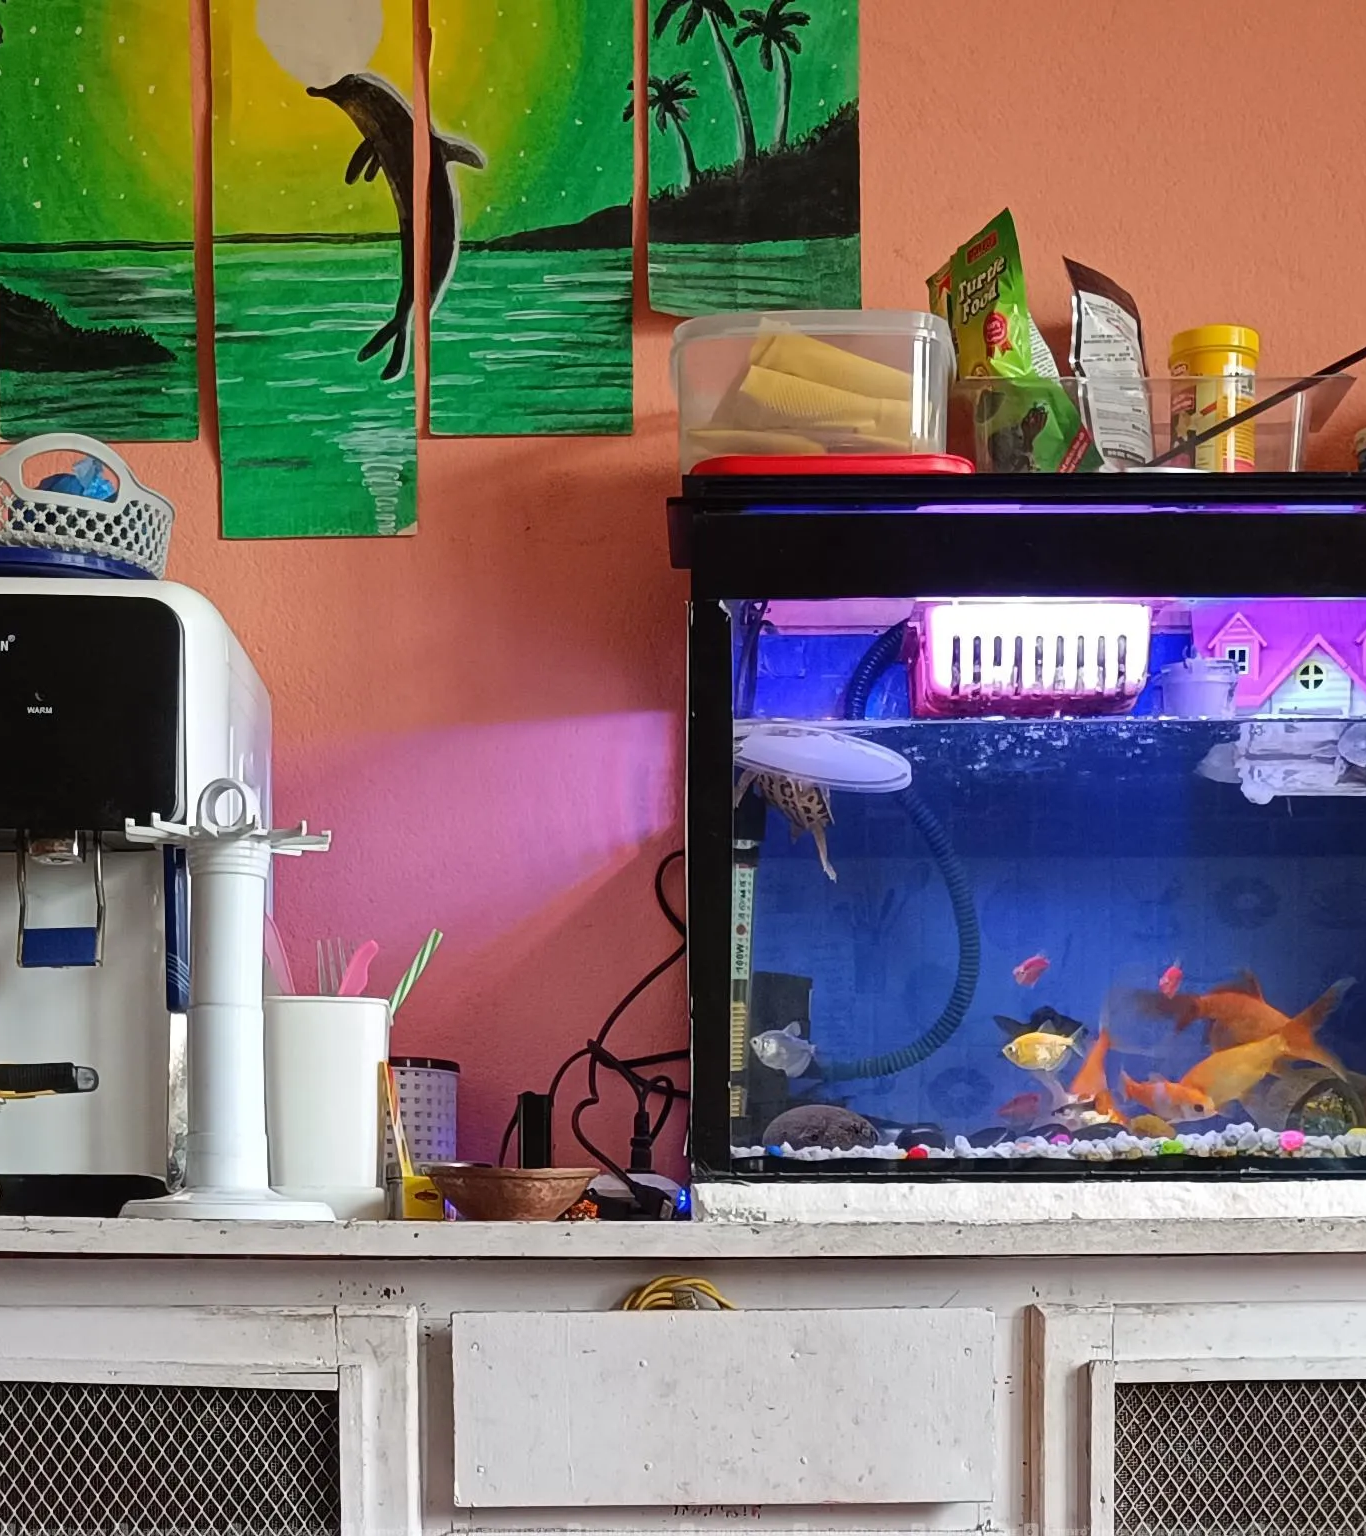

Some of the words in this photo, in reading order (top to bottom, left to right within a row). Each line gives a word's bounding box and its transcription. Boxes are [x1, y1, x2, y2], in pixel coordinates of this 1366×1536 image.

[958, 256, 1005, 304] Turtle
[963, 279, 997, 323] Food
[27, 706, 53, 714] WARM
